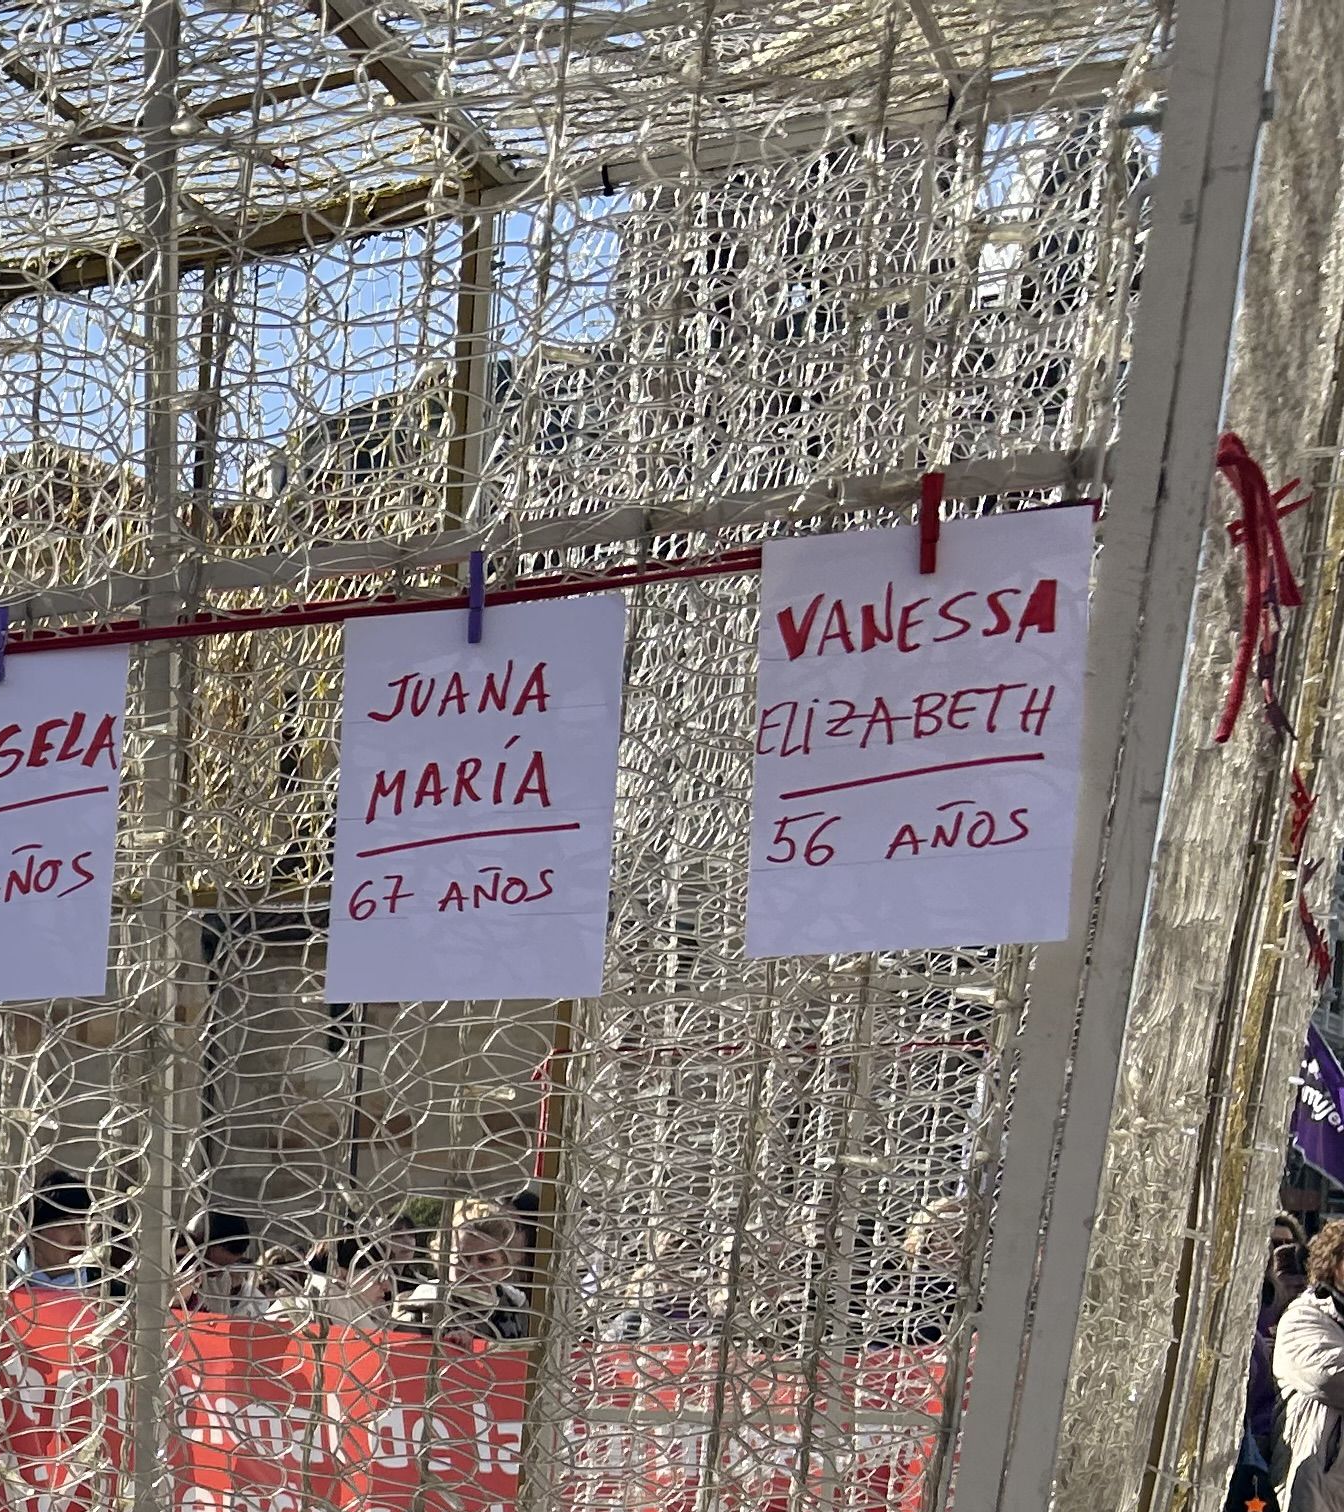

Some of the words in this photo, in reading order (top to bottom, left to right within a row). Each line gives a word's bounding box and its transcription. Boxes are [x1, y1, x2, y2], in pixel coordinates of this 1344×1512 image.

[777, 581, 1058, 661] VANESSA
[368, 662, 550, 722] JUANA
[757, 683, 1055, 758] ELIZABETH
[365, 735, 552, 825] MARÍA
[767, 811, 842, 867] 56
[886, 800, 1030, 859] AÑOS
[348, 875, 414, 921] 67
[438, 867, 554, 913] AÑOS
